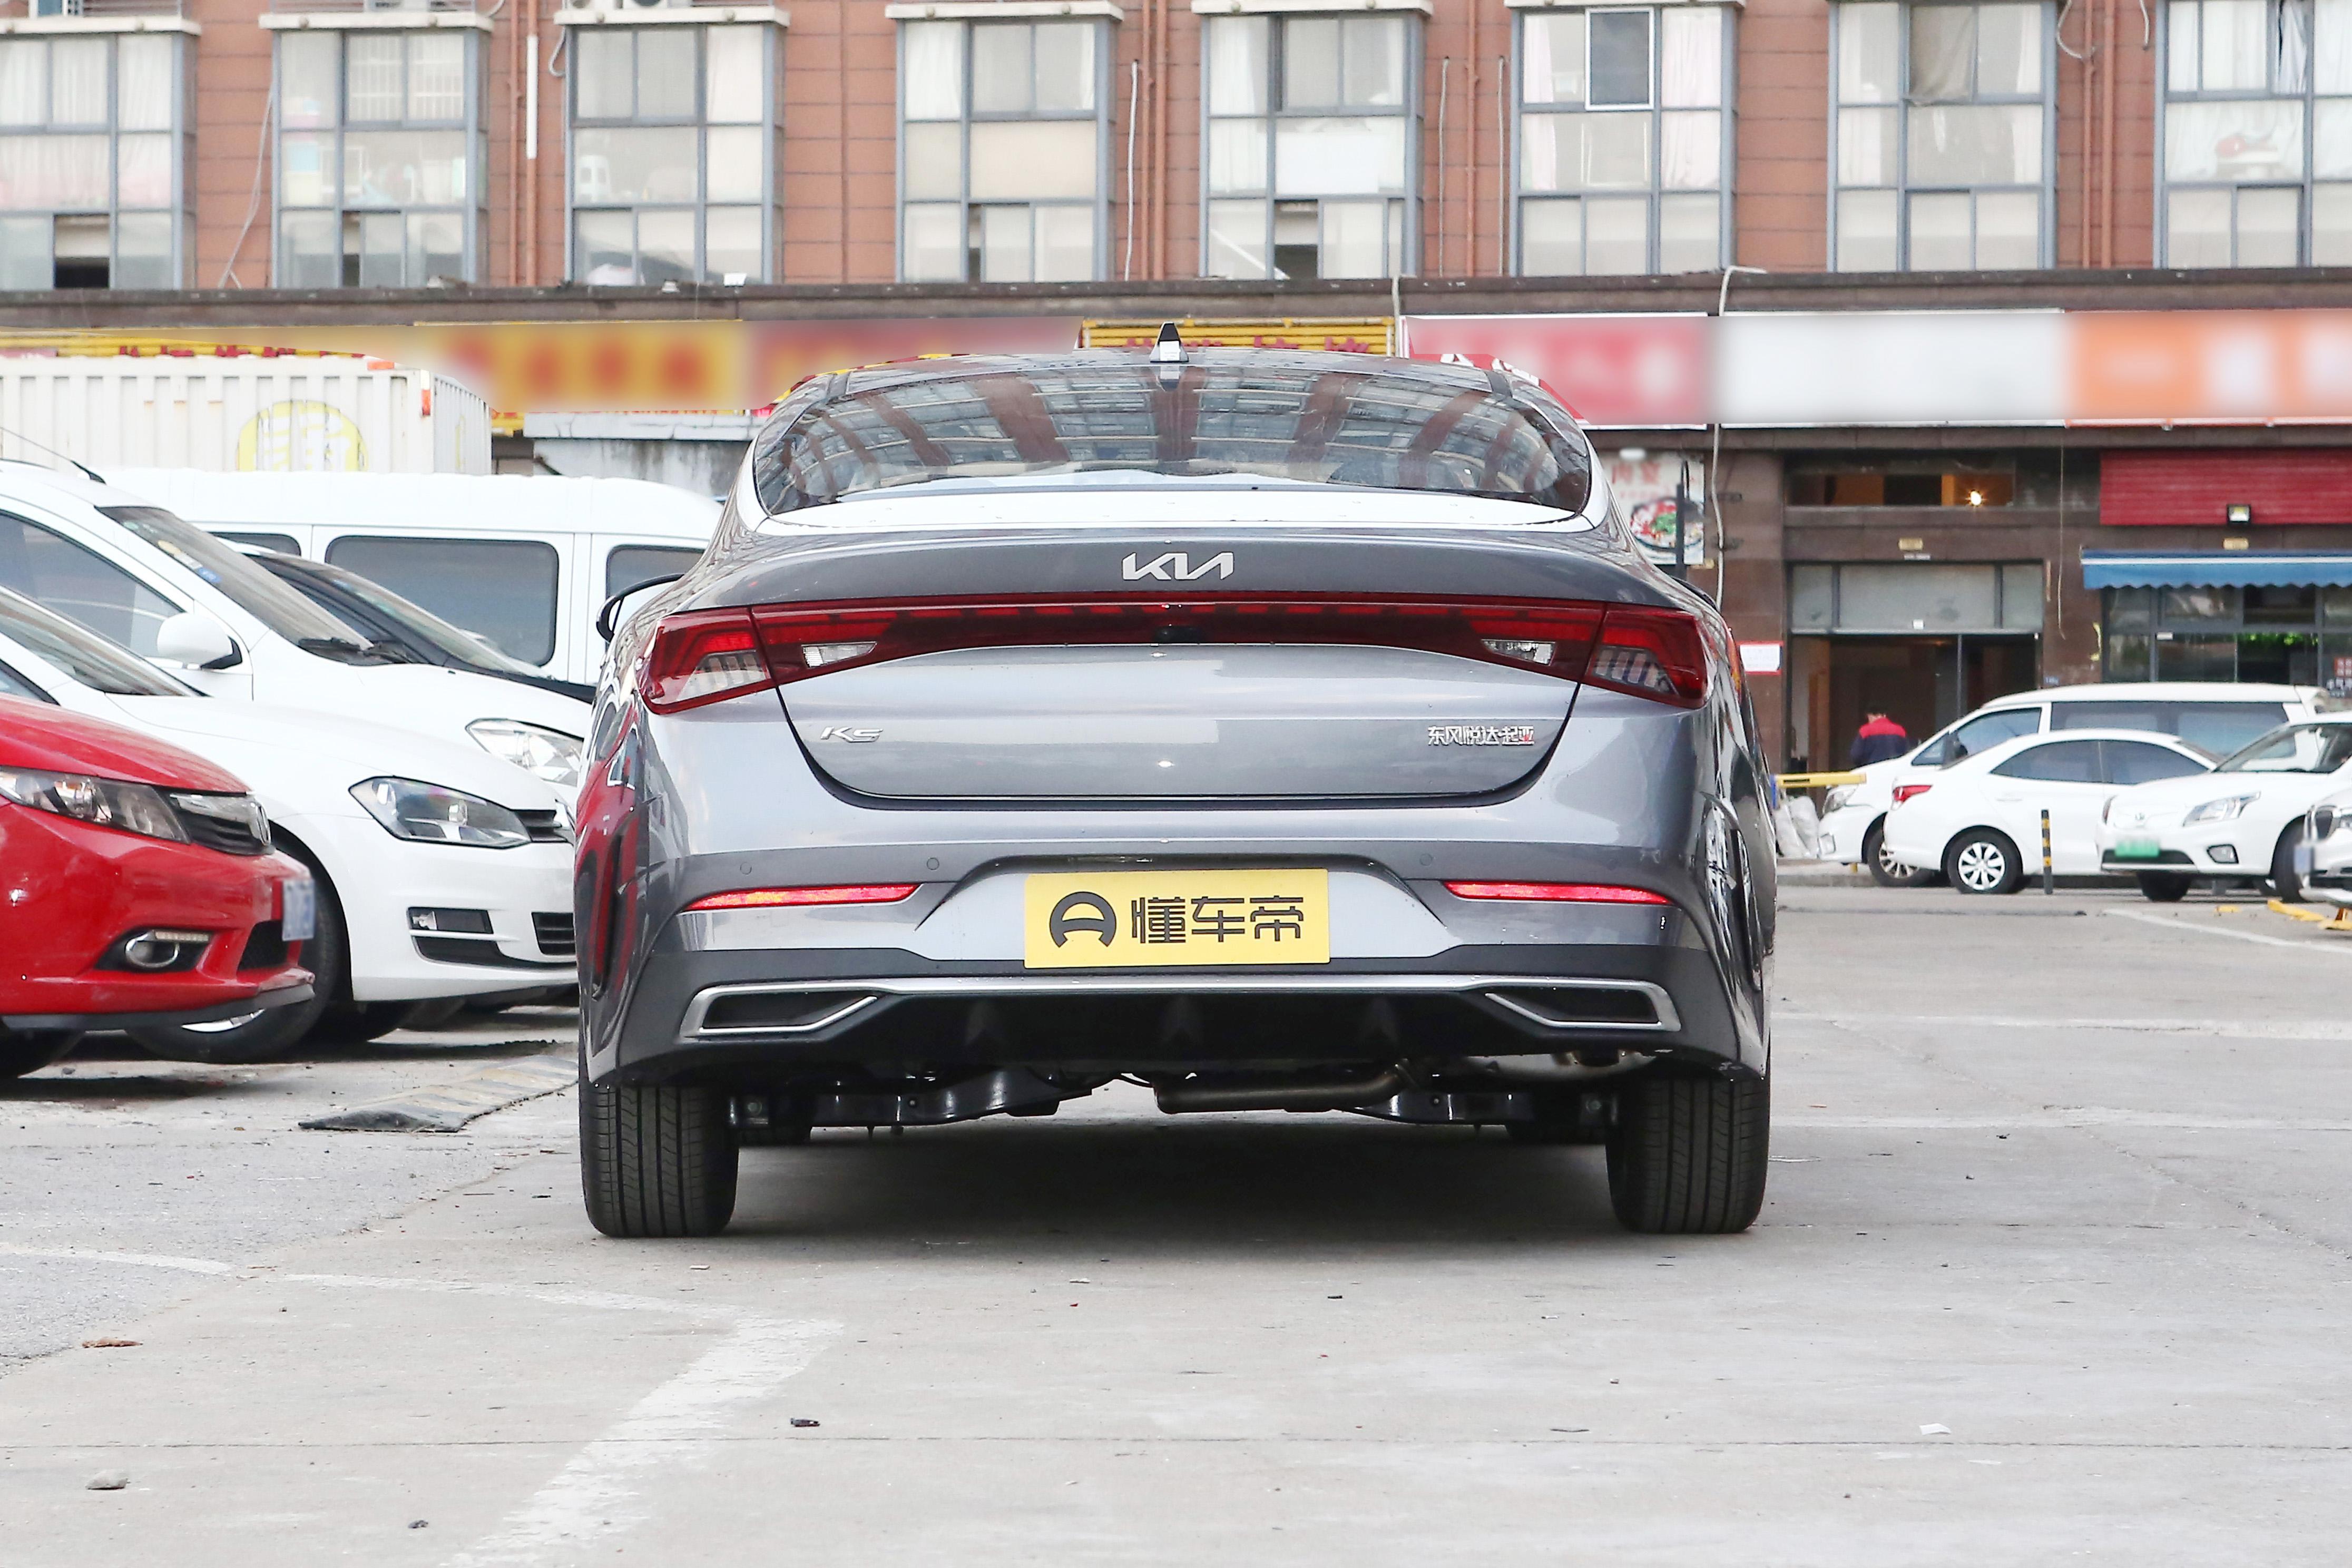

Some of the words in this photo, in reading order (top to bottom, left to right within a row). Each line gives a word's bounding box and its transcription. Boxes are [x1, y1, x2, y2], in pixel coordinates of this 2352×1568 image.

[820, 726, 884, 743] K5
[1131, 895, 1304, 944] 懂车帝
